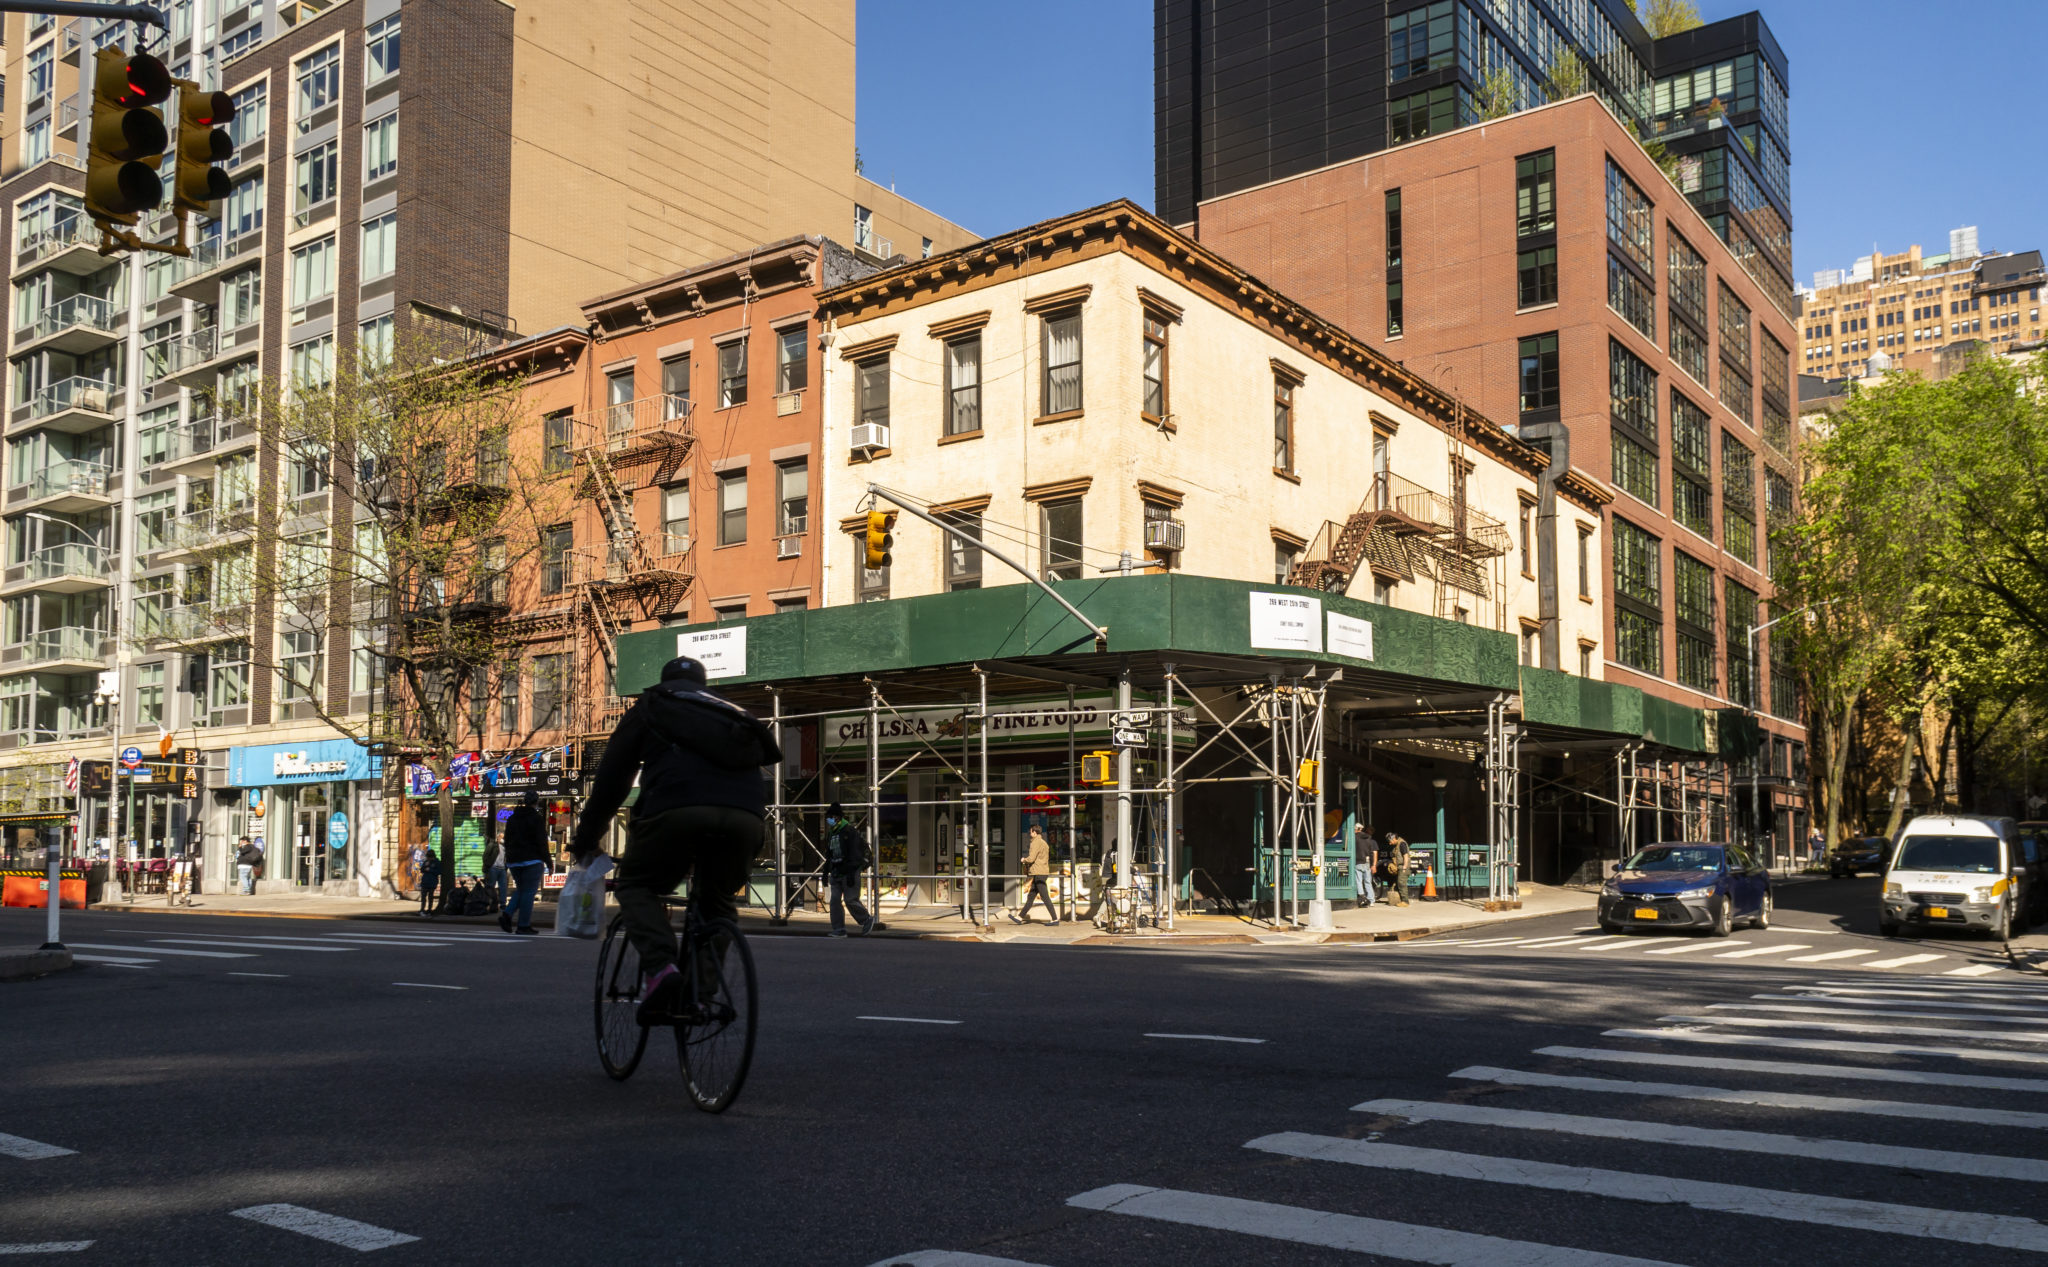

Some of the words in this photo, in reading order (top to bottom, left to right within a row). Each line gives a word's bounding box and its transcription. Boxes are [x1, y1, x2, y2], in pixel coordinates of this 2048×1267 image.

[838, 718, 929, 740] CHLSEA
[993, 710, 1038, 730] FINE
[1042, 705, 1098, 727] FOOD
[1119, 732, 1129, 740] ONE
[183, 750, 198, 798] BAR
